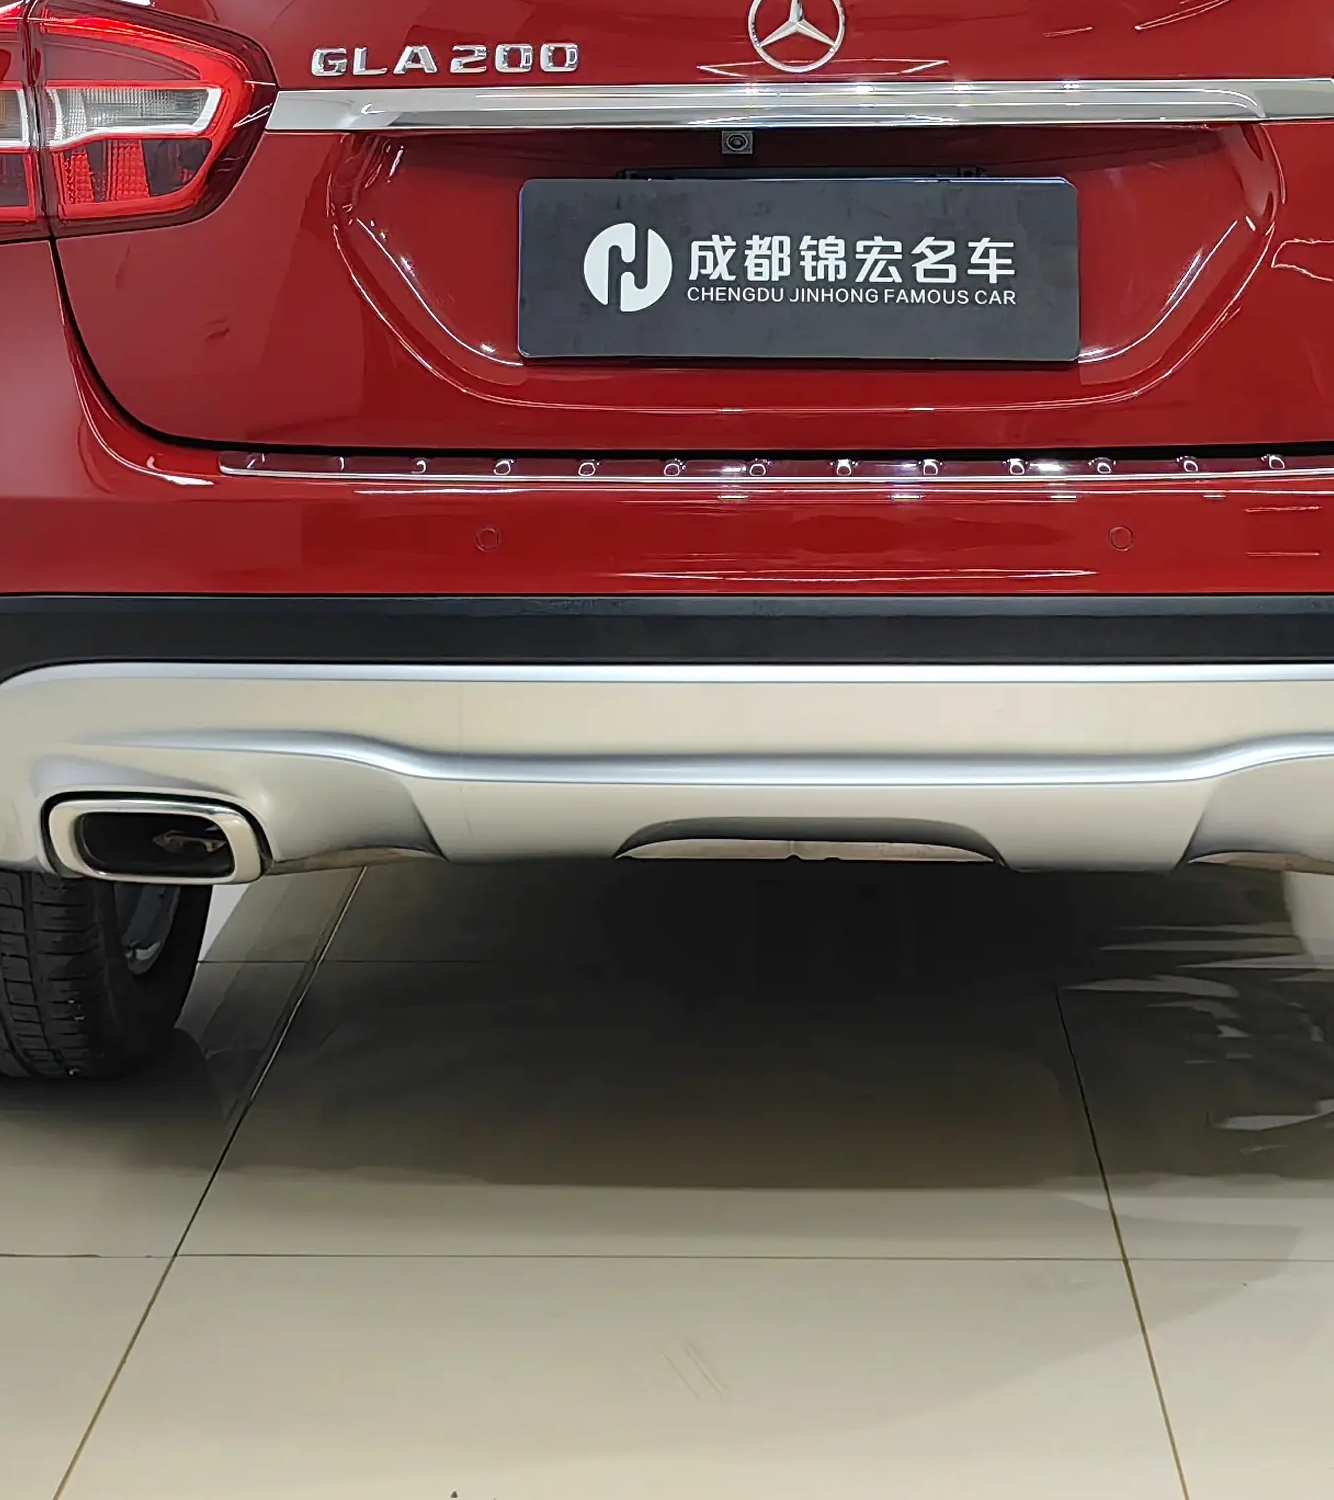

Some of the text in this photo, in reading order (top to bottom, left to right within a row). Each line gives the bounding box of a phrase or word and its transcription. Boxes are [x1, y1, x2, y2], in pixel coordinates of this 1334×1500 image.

[311, 43, 578, 77] GLA 200
[688, 234, 1015, 284] 成都锦宏名车
[687, 286, 1017, 305] CHENGDU JINHONG FAMOUS CAR
